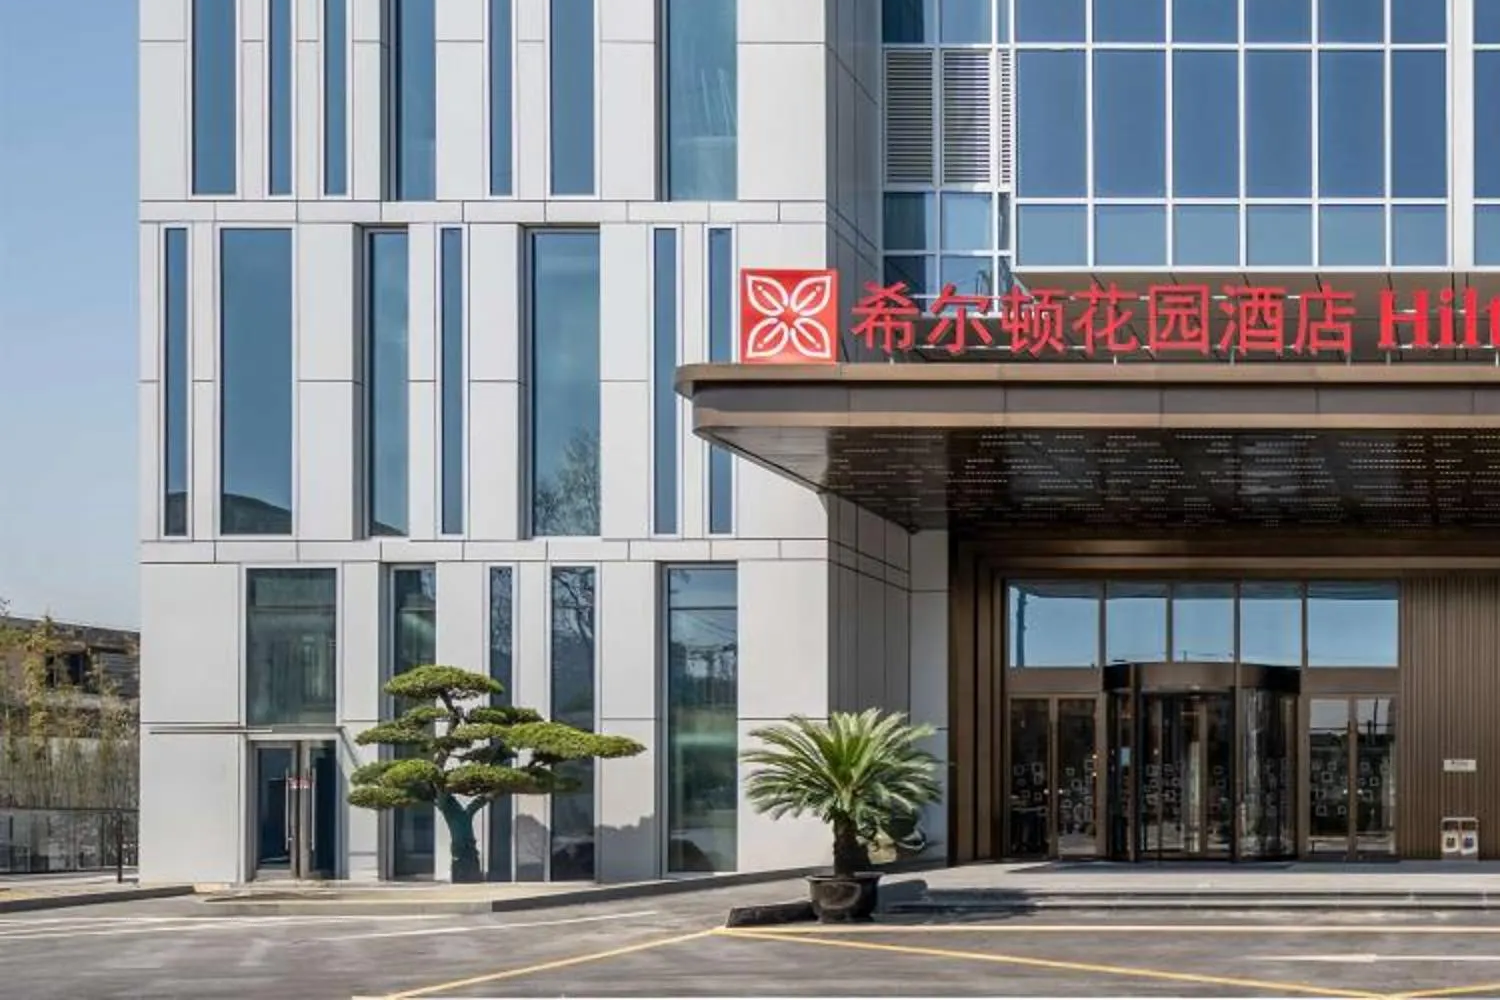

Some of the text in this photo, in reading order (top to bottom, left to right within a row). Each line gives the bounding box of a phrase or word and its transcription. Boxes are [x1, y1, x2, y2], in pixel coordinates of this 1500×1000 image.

[851, 281, 1357, 355] 希尔顿花园酒店
